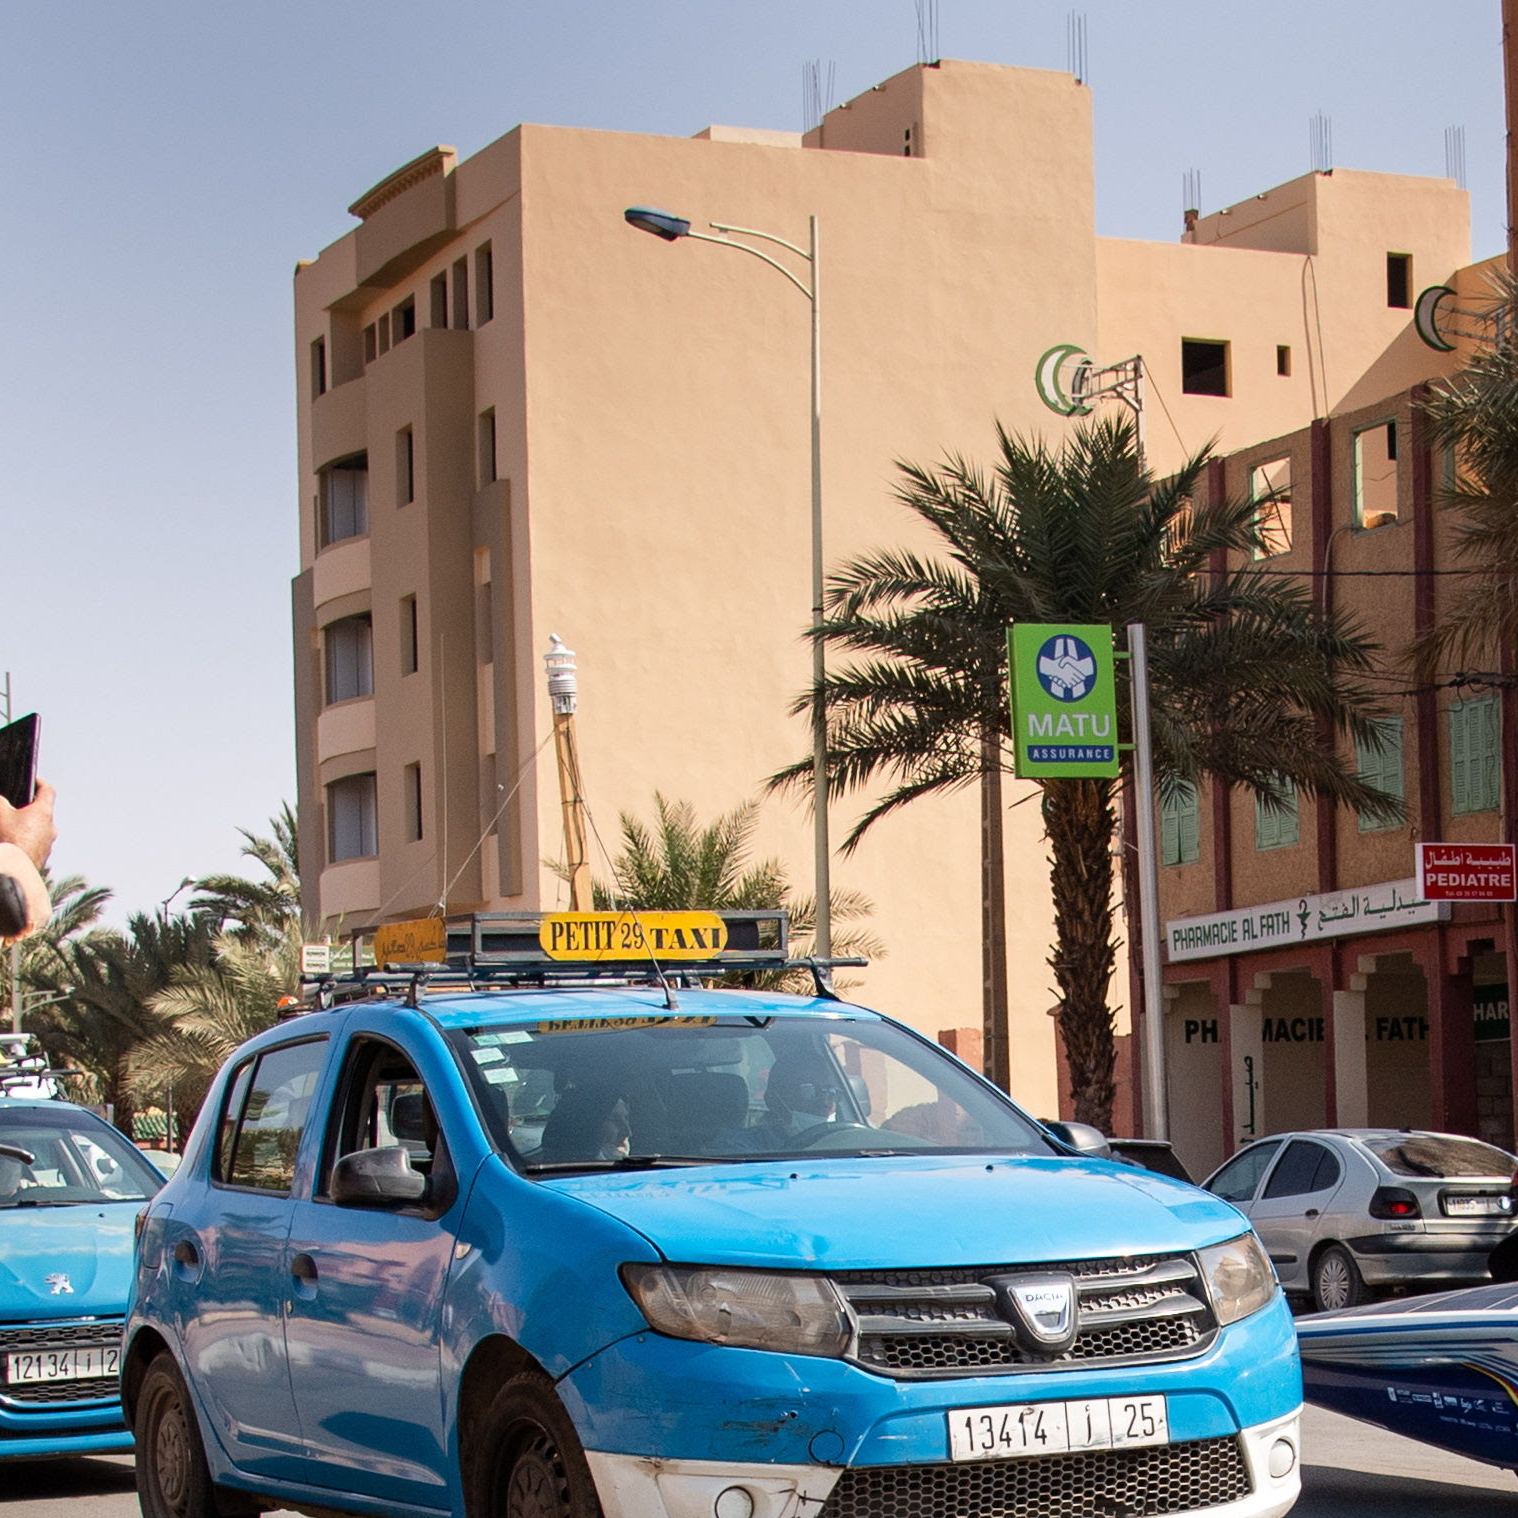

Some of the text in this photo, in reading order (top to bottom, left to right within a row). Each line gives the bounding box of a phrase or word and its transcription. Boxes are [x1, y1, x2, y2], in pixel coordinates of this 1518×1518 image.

[1027, 713, 1111, 737] MATU
[1033, 749, 1110, 759] ASSURANCE
[1426, 873, 1511, 887] PEDIATRE
[1317, 895, 1359, 931] الفتح
[551, 921, 722, 950] PETIT 29 TAXI
[1173, 911, 1290, 951] PHARMACIE AL FATH
[1026, 1293, 1064, 1303] DACIA
[14, 1352, 69, 1380] 12134
[107, 1350, 118, 1372] 2
[965, 1410, 1048, 1452] 13414
[1124, 1402, 1155, 1438] 25
